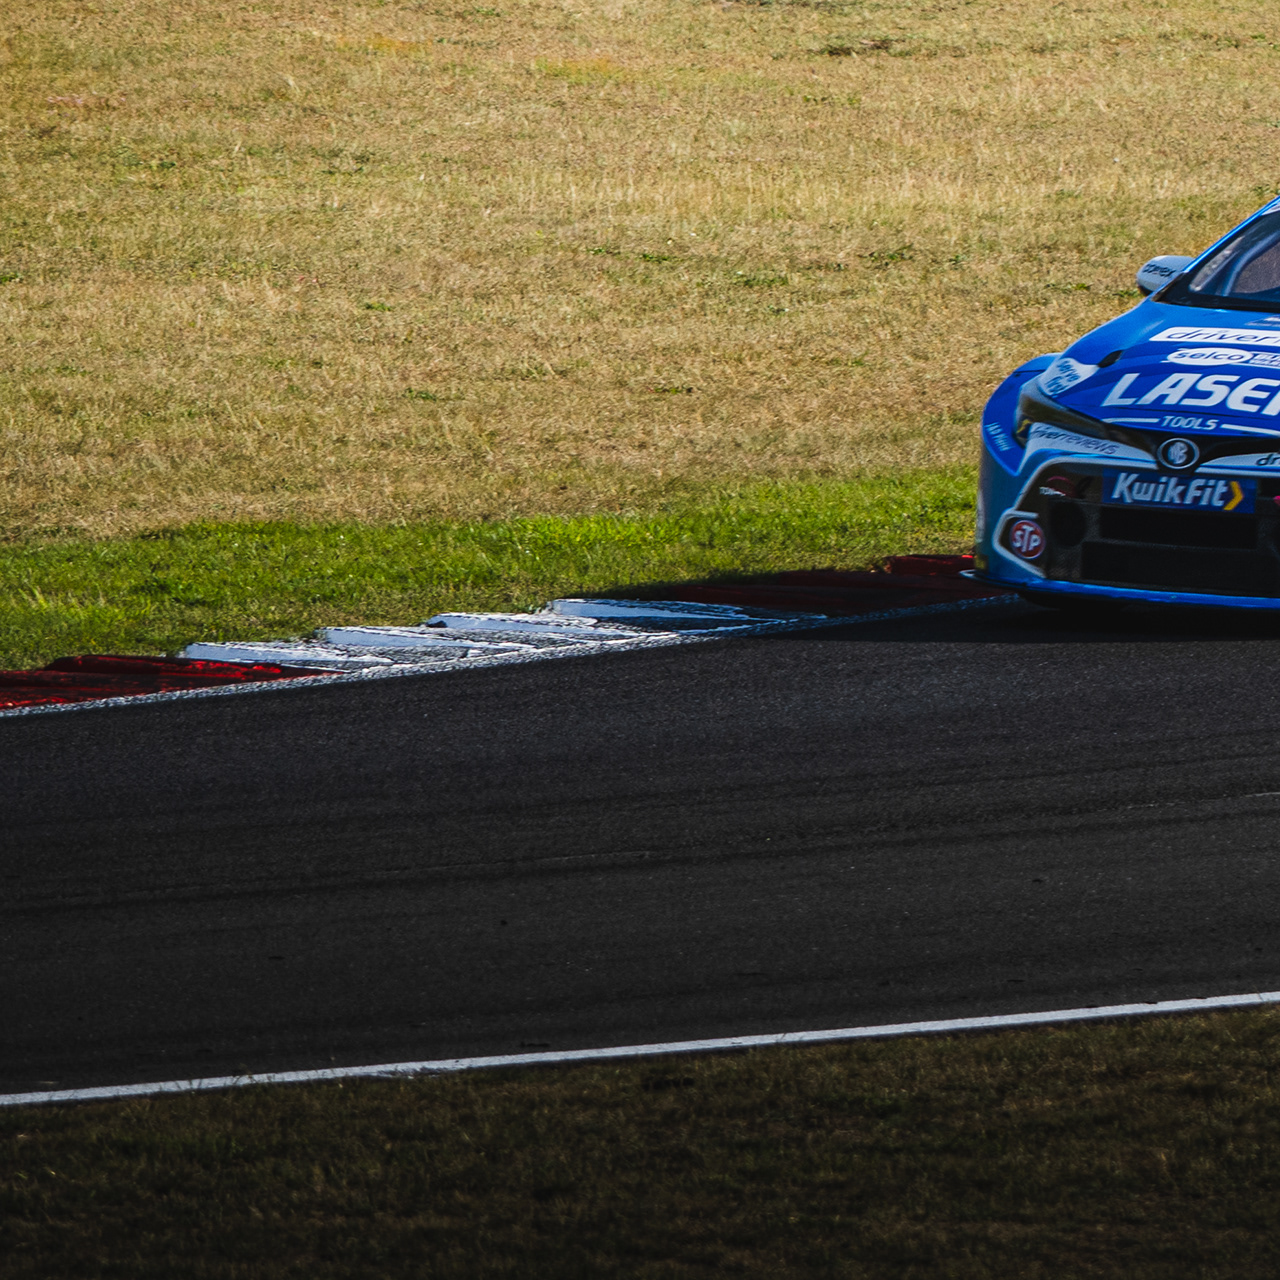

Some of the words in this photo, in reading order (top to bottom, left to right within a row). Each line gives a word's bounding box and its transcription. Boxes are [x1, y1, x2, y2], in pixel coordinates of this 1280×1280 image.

[1055, 357, 1082, 383] serve
[1162, 415, 1220, 430] TOOLS
[1110, 472, 1229, 508] KwikFit
[1012, 524, 1042, 553] STP
